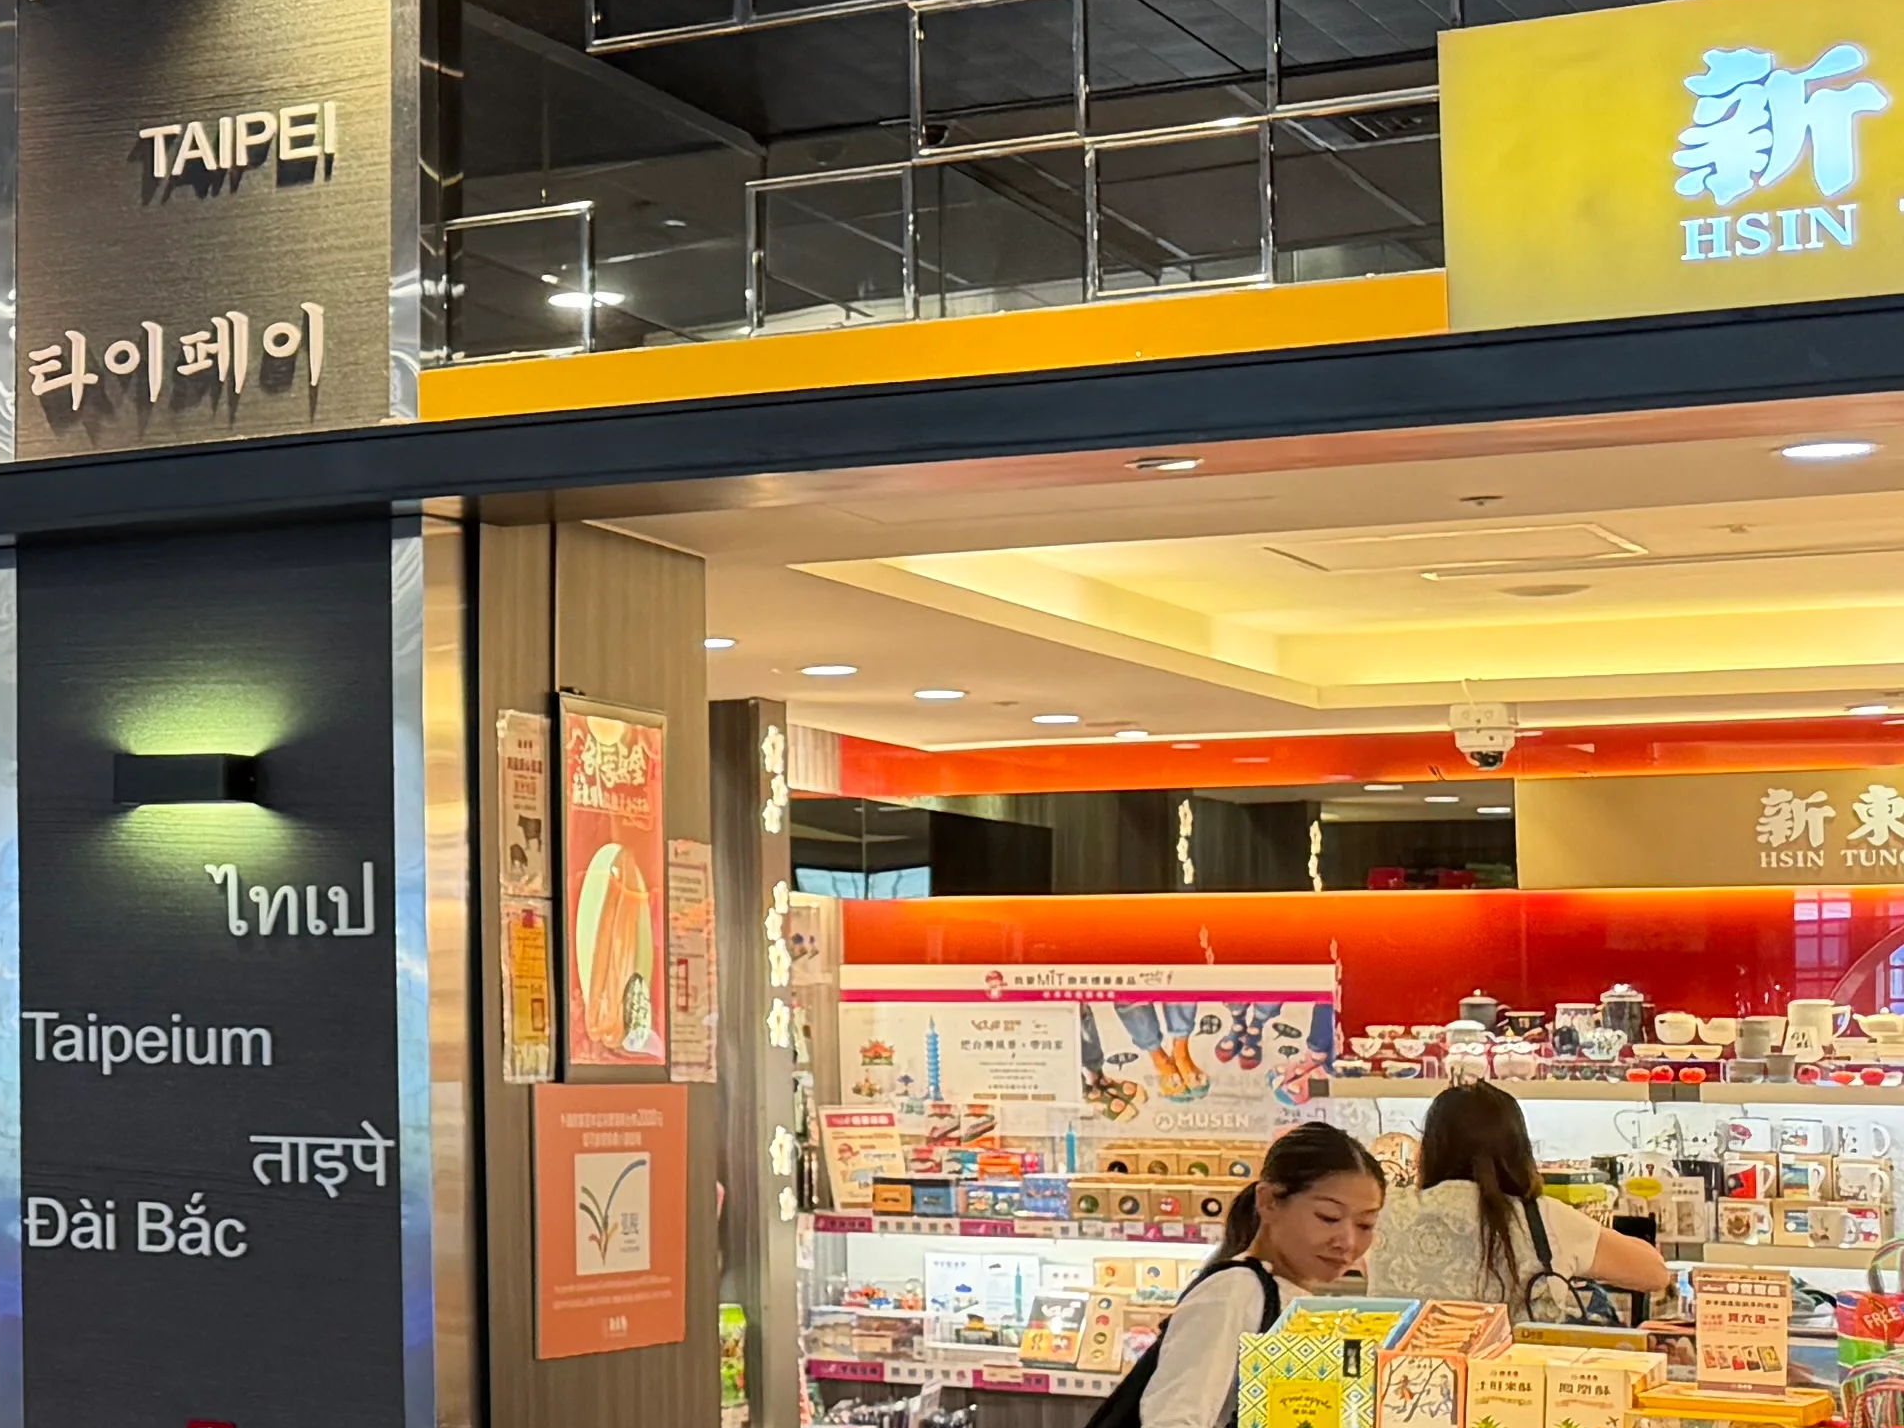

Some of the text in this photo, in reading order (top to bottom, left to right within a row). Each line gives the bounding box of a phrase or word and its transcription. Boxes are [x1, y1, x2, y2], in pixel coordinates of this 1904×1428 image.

[138, 100, 337, 178] TAIPEI
[1672, 44, 1888, 206] 新
[1680, 203, 1857, 262] HSIN
[27, 301, 325, 411] 타이페이
[1760, 850, 1824, 868] HSIN
[204, 861, 376, 938] ไทเป
[21, 1011, 273, 1075] Taipeium
[1176, 1113, 1250, 1128] MUSEN
[249, 1120, 396, 1199] ताइपे
[23, 1192, 250, 1258] Đài Bắc
[1863, 1306, 1902, 1330] FREE
